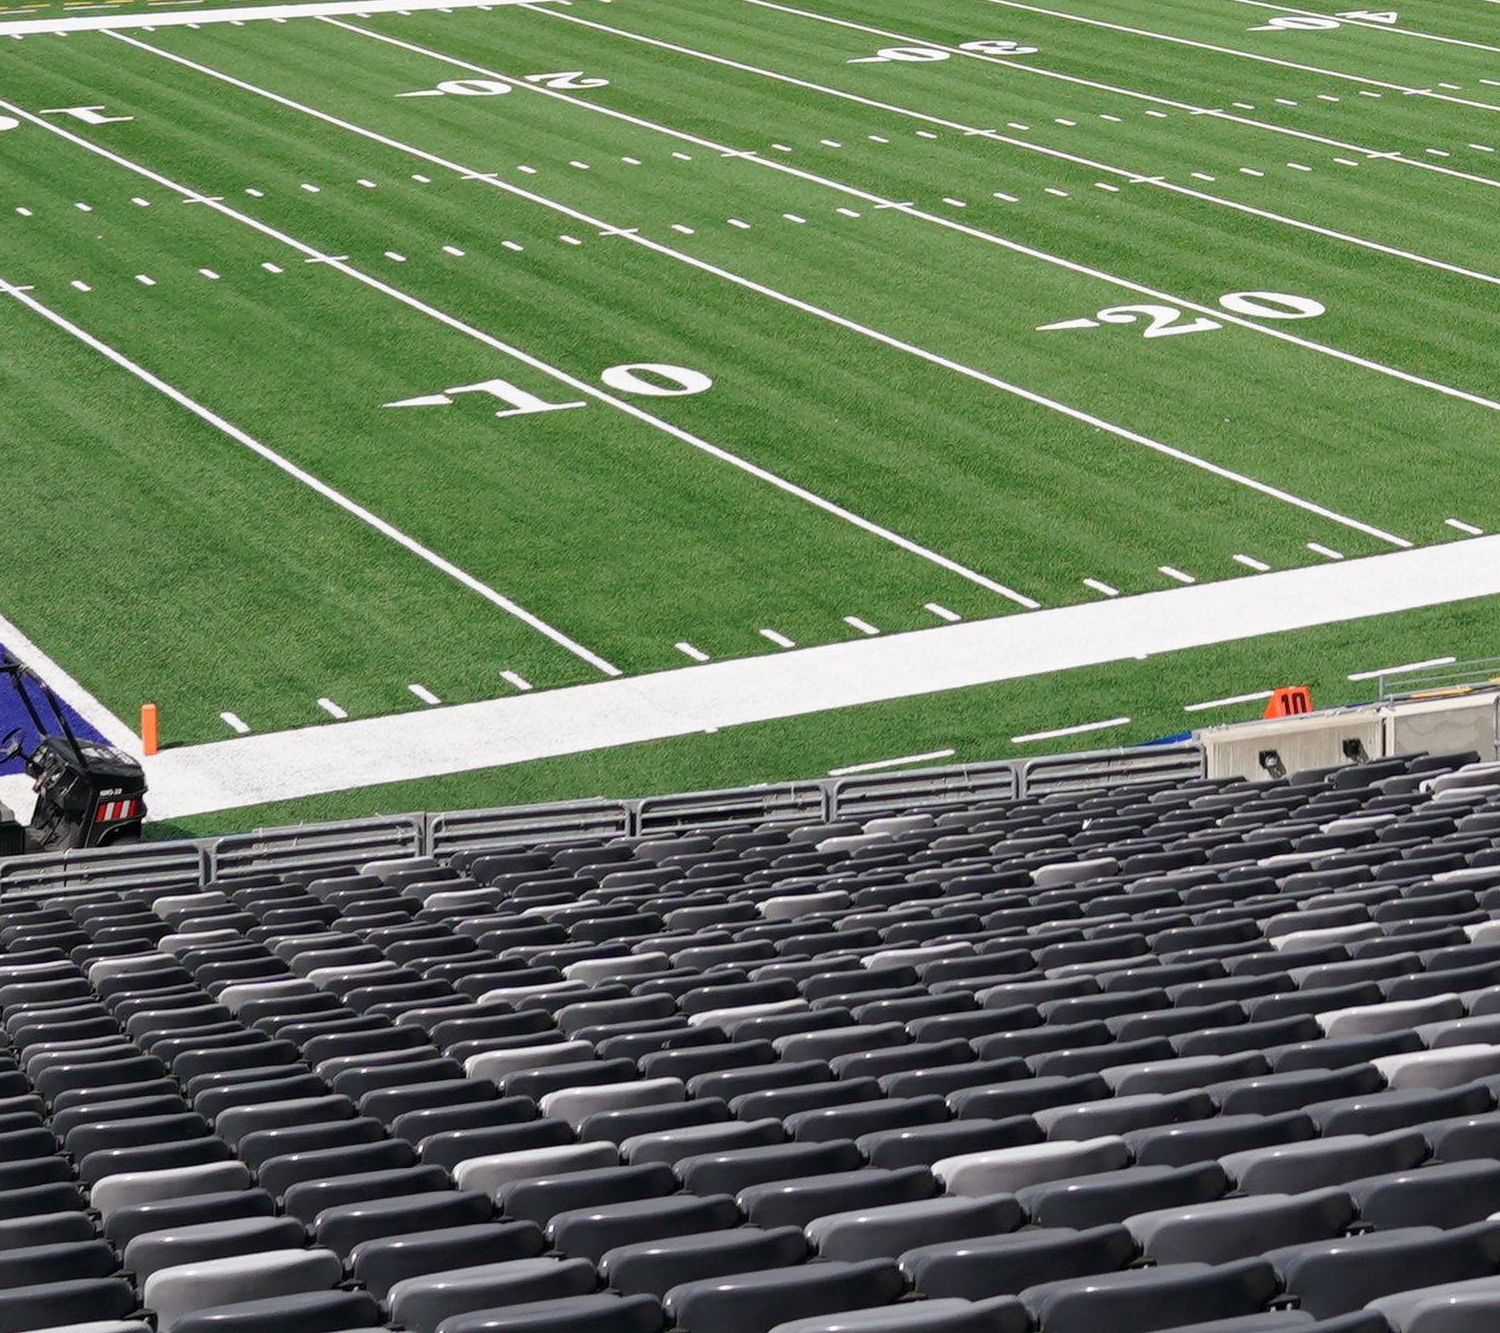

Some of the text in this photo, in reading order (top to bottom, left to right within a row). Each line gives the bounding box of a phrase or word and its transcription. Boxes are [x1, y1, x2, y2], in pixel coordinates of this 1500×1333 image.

[1097, 291, 1326, 337] 20
[445, 362, 713, 418] 10
[1282, 693, 1307, 715] 10
